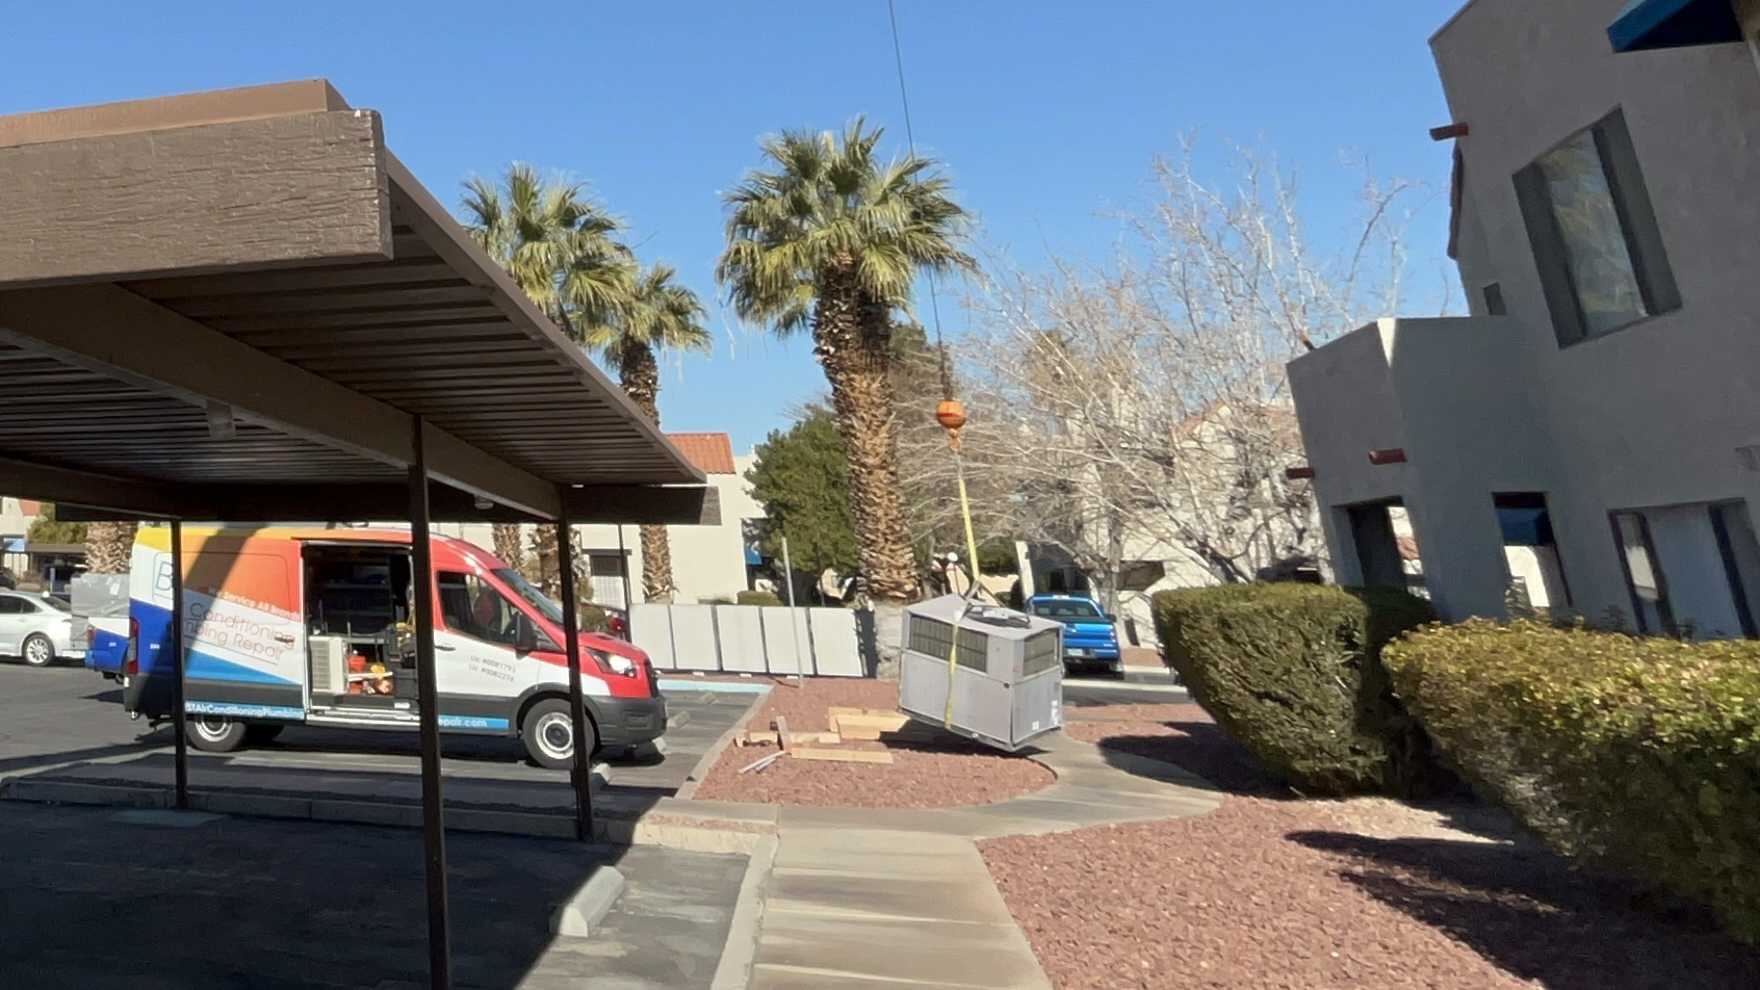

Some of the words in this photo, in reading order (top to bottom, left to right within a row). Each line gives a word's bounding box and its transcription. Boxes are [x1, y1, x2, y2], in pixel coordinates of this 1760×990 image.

[223, 591, 256, 608] Service
[257, 600, 270, 611] All
[189, 602, 296, 651] Conditioning
[234, 633, 284, 660] Repair
